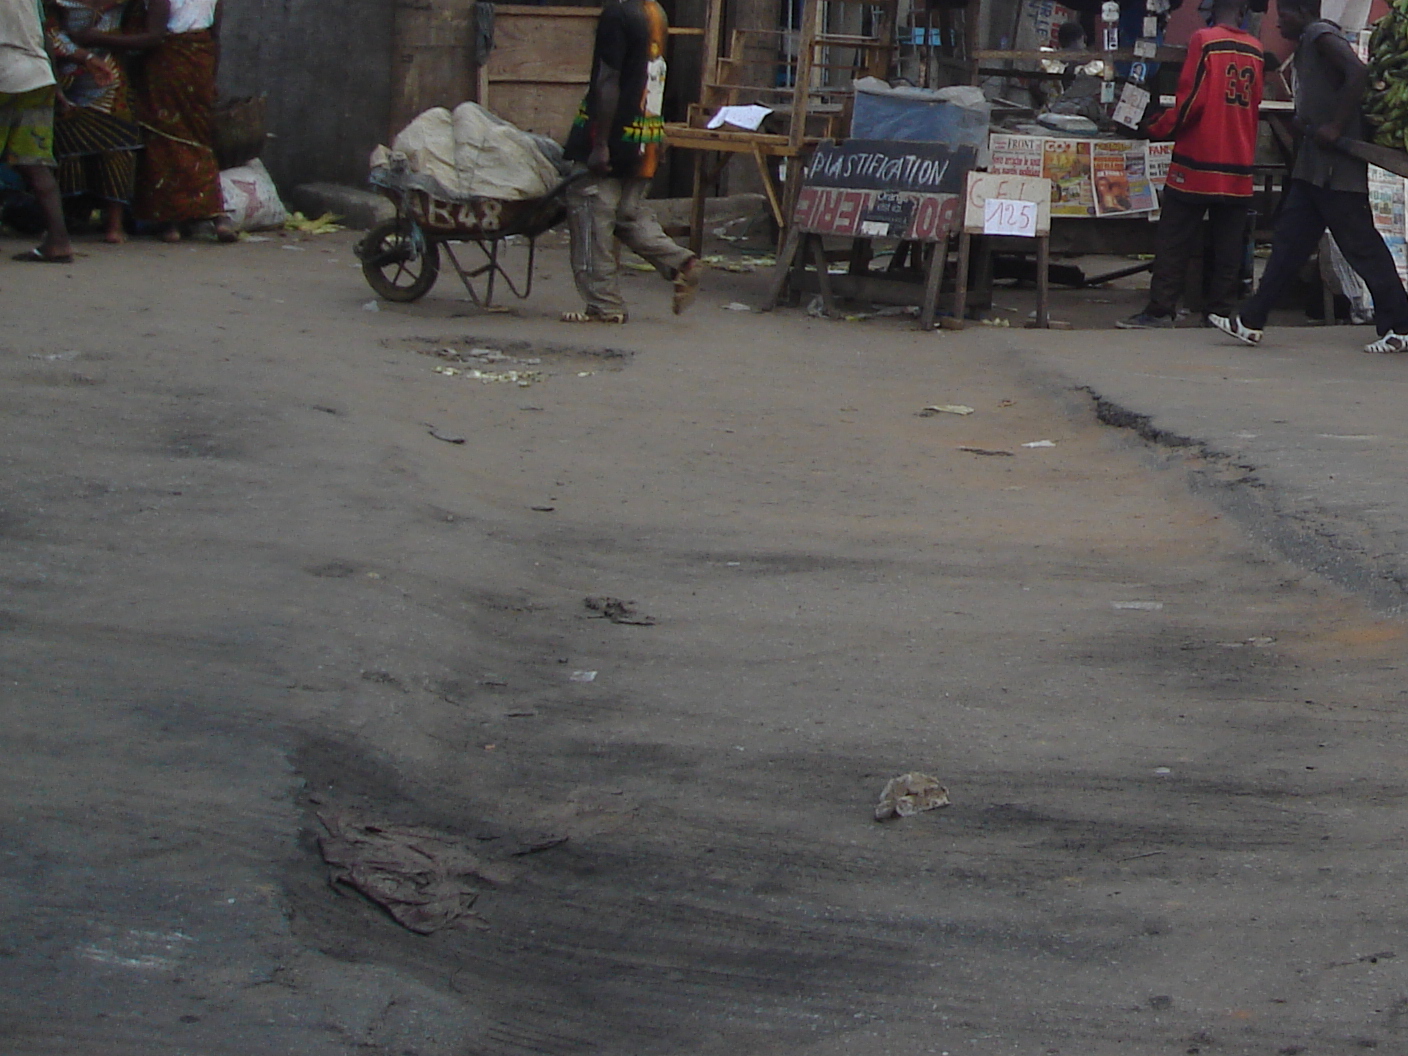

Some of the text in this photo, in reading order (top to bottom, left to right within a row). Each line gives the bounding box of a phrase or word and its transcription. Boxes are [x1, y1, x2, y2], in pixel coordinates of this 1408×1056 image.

[1225, 61, 1255, 109] 33
[1008, 138, 1035, 150] FRONT
[810, 152, 949, 186] PLASTIFICATION
[986, 202, 1031, 229] 125
